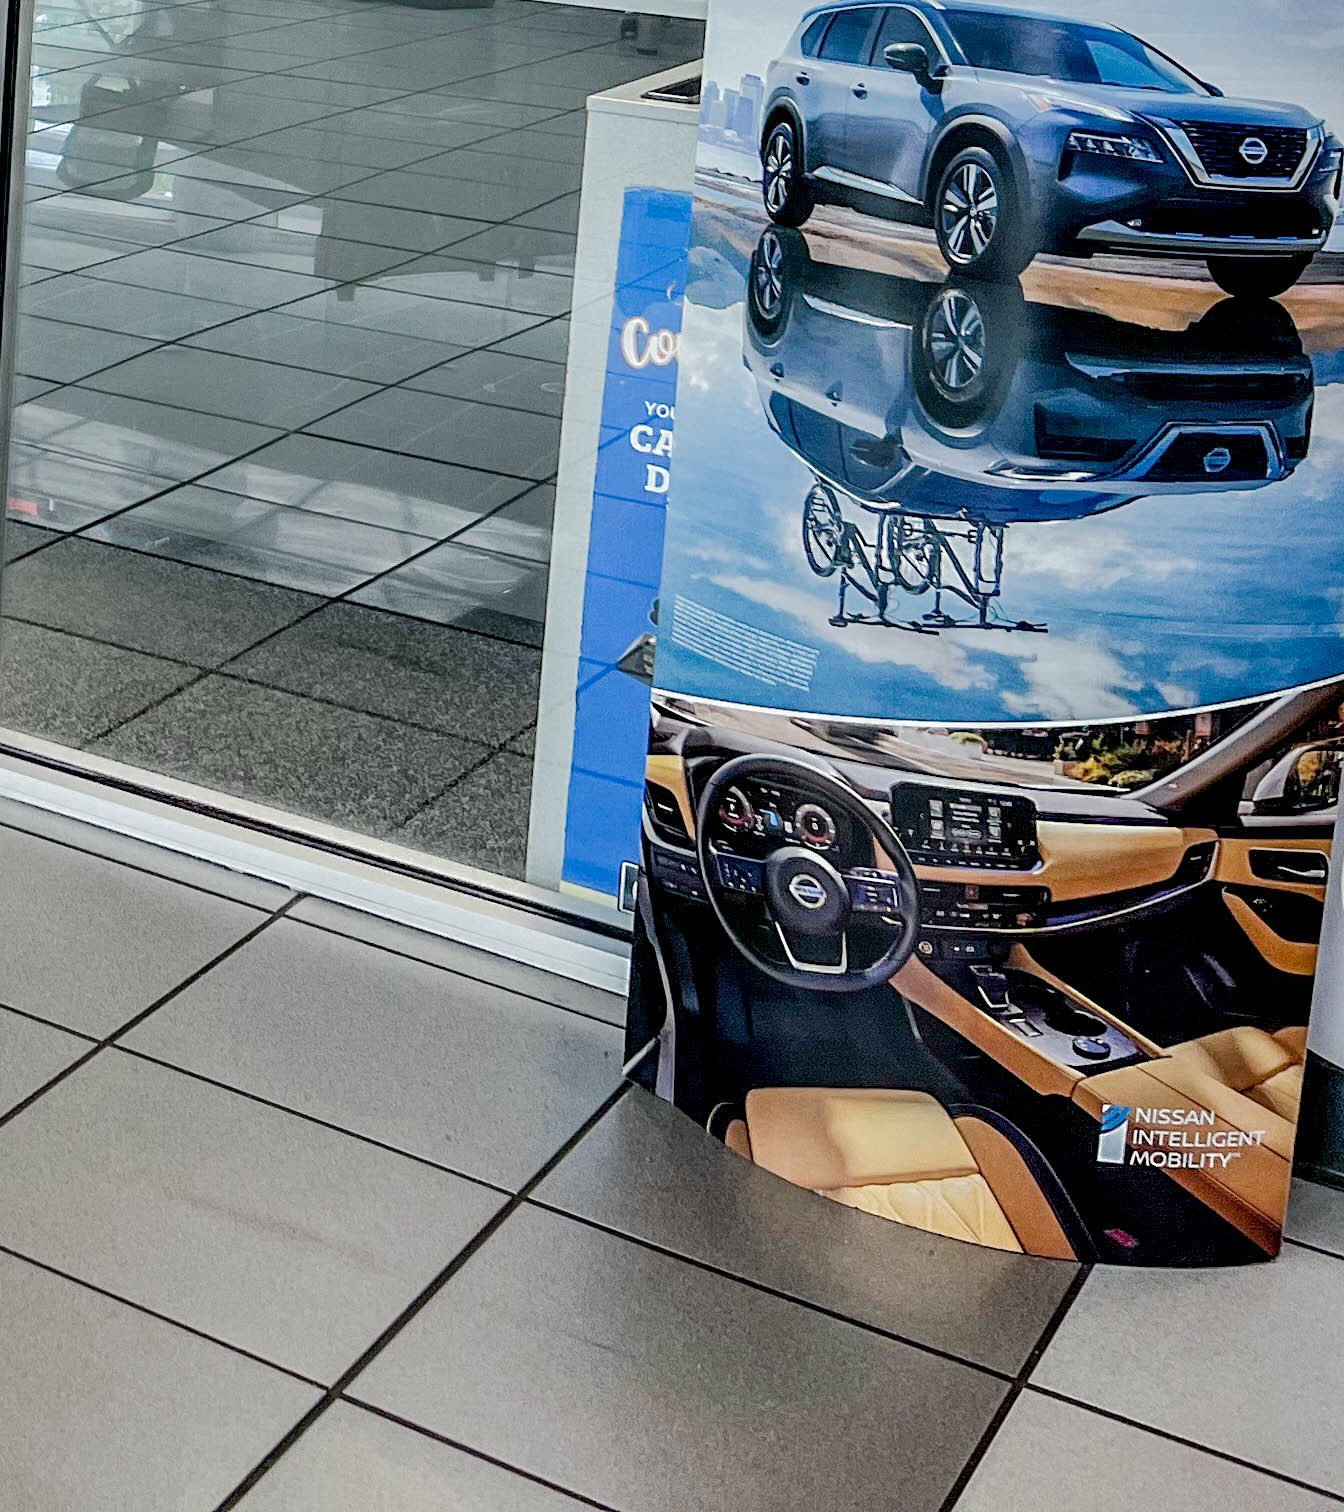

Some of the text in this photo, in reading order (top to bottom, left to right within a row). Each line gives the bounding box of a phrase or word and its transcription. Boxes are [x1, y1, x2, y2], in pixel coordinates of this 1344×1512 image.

[621, 316, 681, 370] Co
[1134, 1107, 1216, 1126] NISSAN
[1132, 1129, 1267, 1148] INTELLIGENT
[1129, 1150, 1233, 1169] MOBILITY
